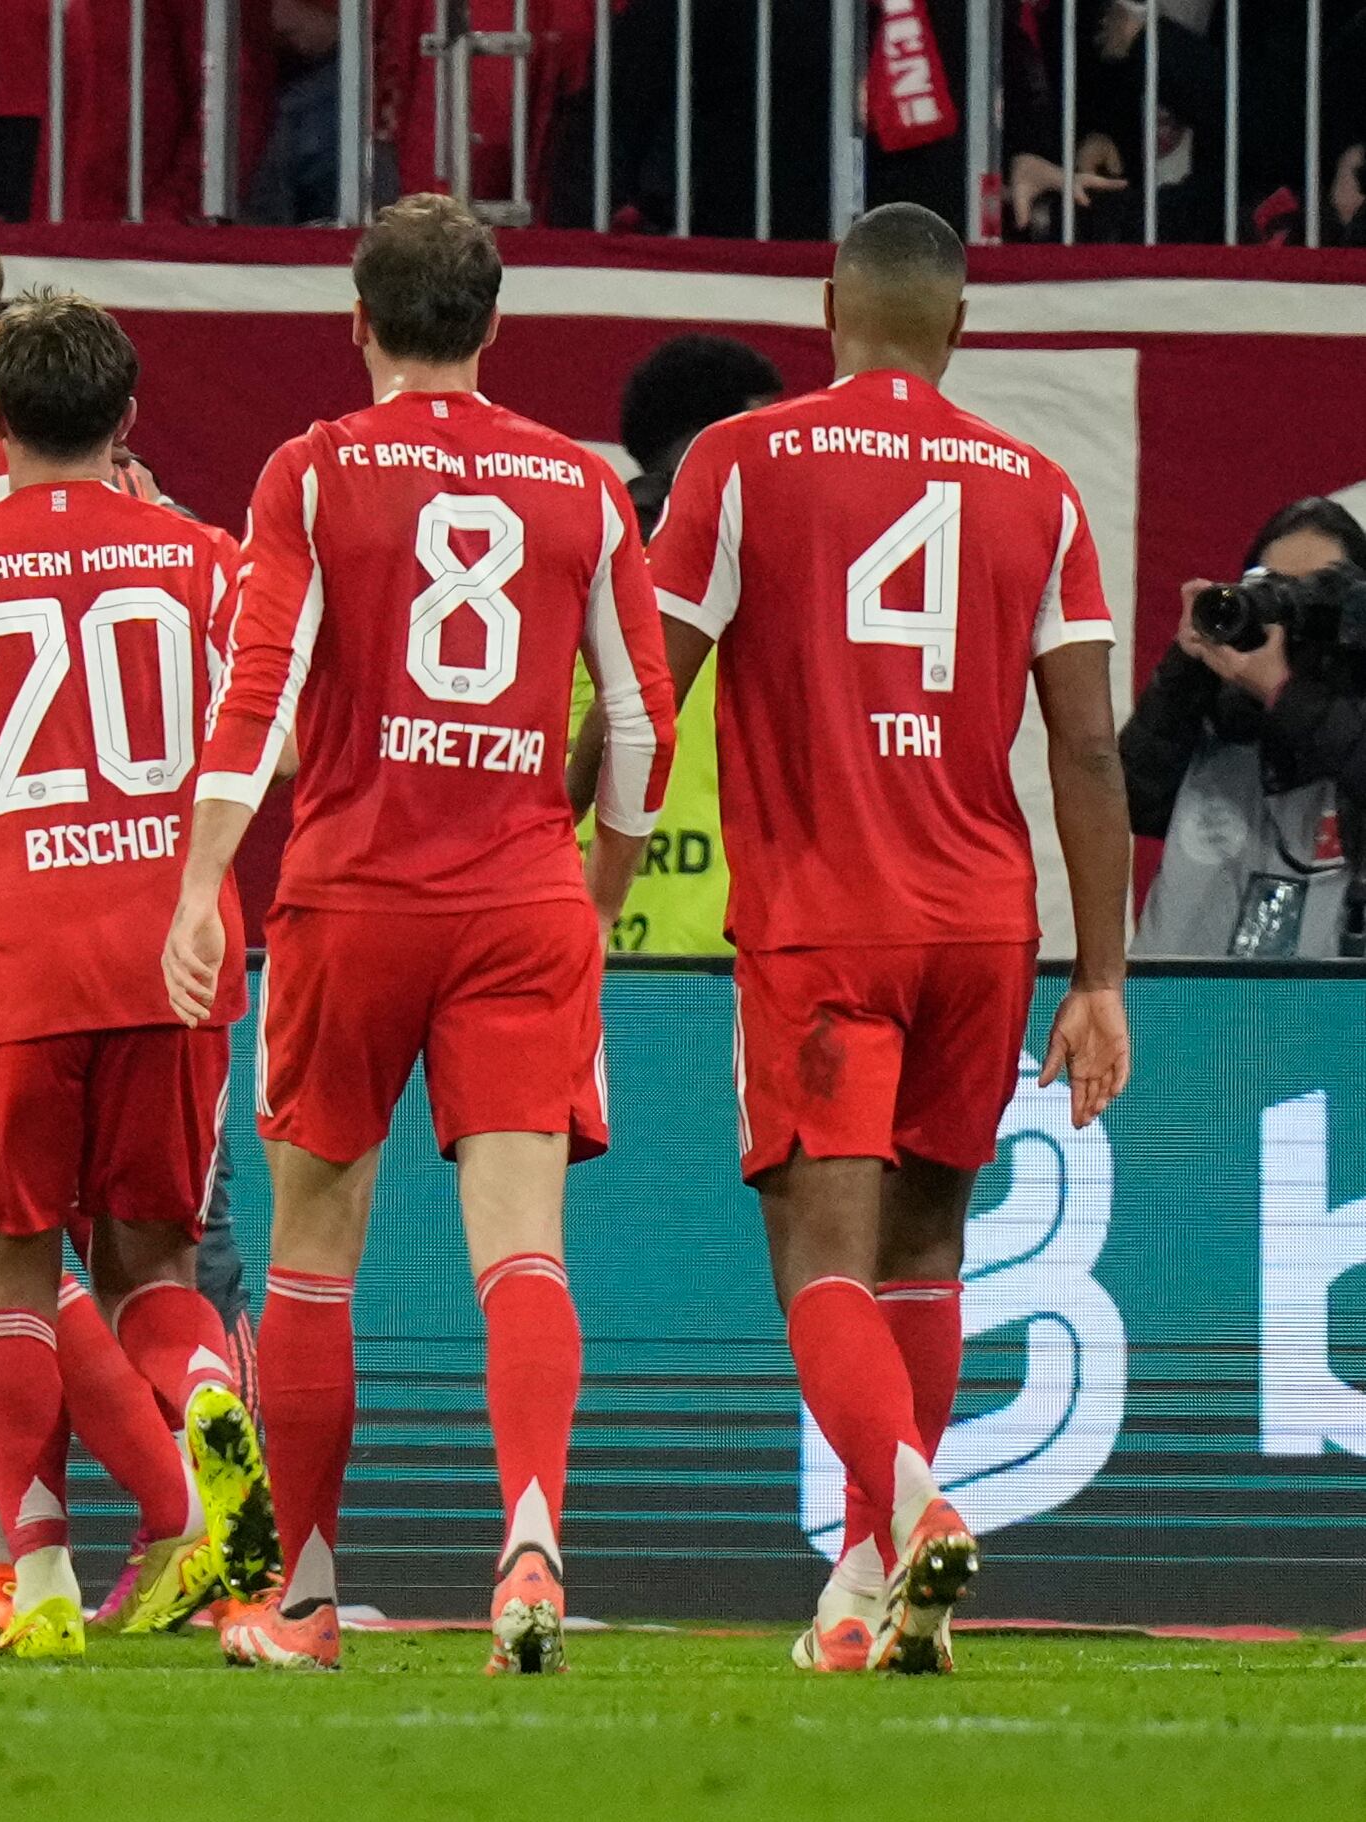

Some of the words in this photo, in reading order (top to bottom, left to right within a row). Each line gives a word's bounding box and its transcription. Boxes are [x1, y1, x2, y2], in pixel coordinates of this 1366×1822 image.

[338, 444, 370, 467] FC
[375, 442, 466, 479] BAYERN
[475, 452, 585, 488] MÜNCHEN
[769, 429, 802, 459] FC
[811, 427, 909, 461] BAYERN
[921, 436, 1031, 479] MÜNCHEN
[82, 543, 194, 574] MÜNCHEN
[405, 491, 525, 705] 8
[846, 480, 961, 692] 4
[870, 712, 942, 759] TAH
[25, 814, 181, 872] BISCHOF
